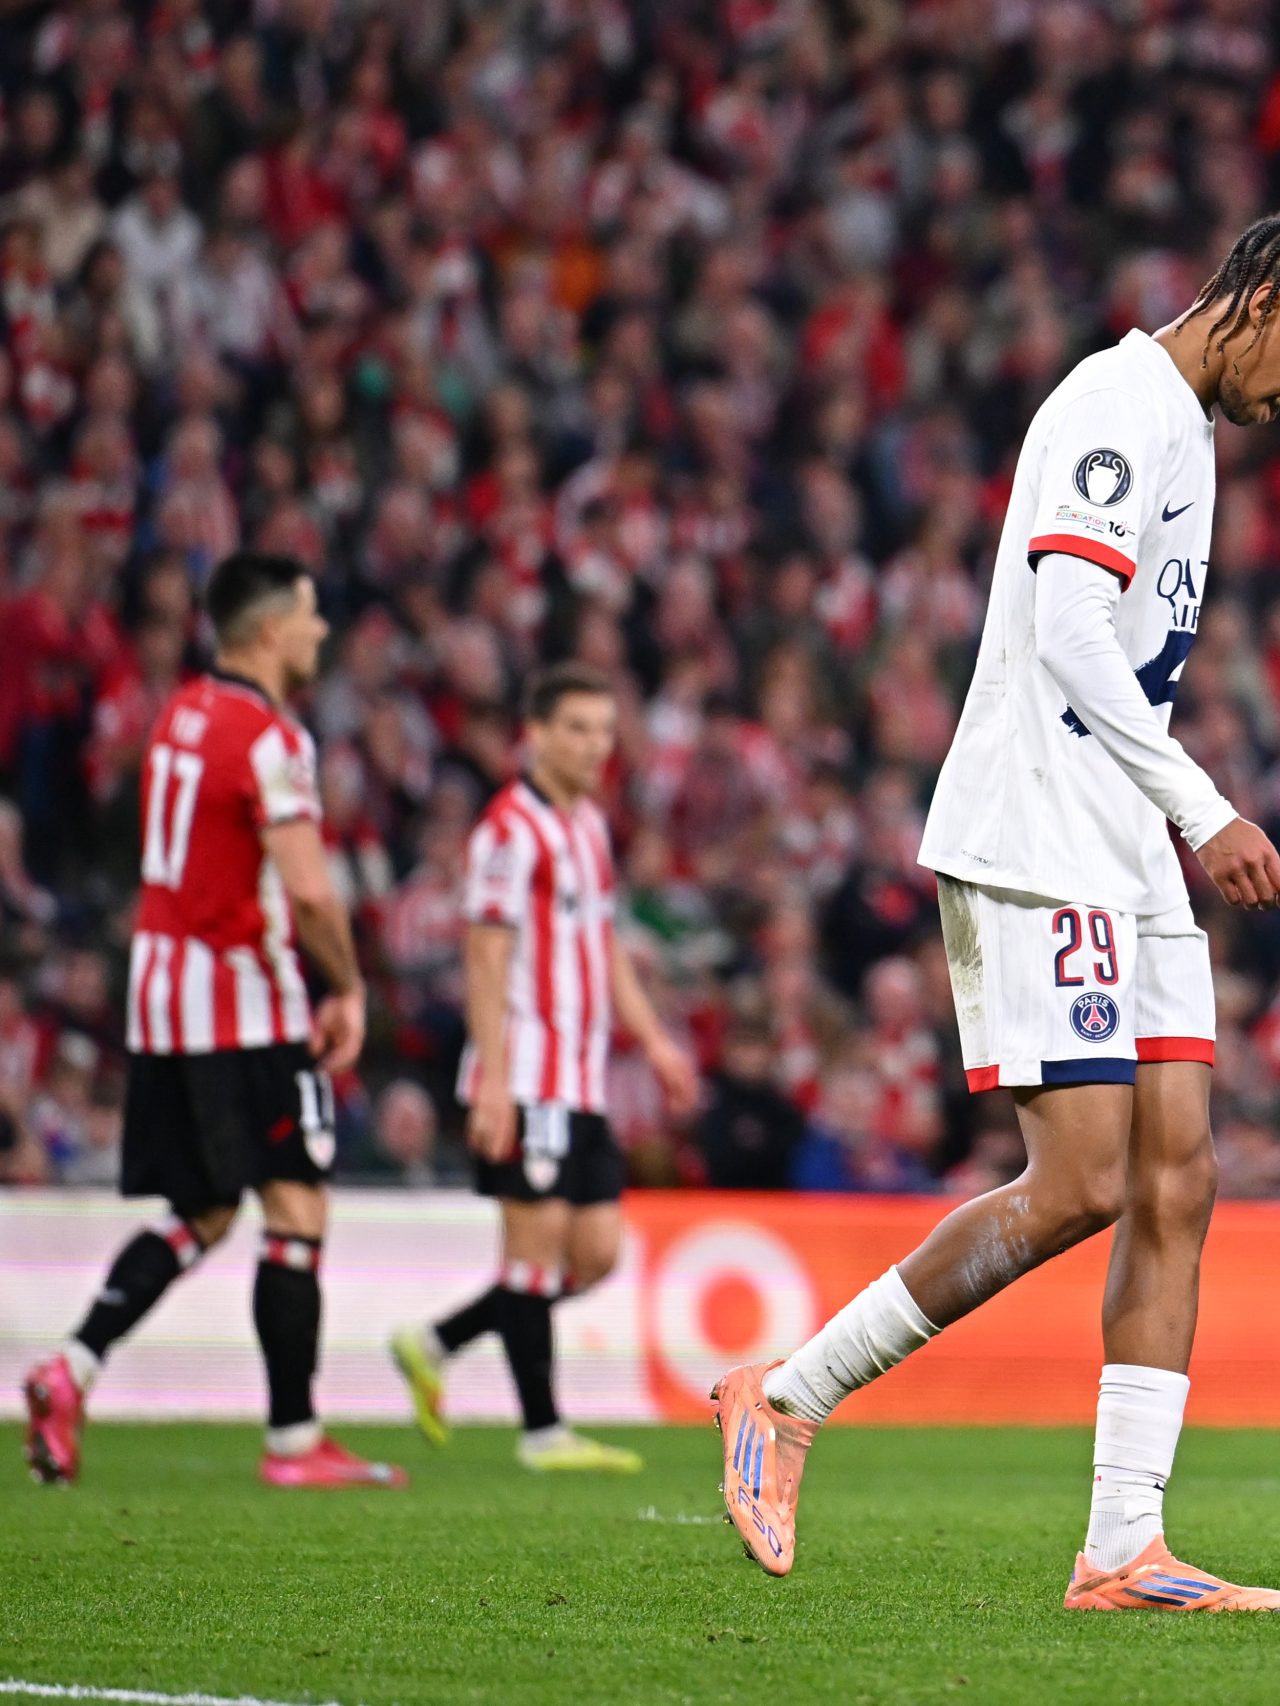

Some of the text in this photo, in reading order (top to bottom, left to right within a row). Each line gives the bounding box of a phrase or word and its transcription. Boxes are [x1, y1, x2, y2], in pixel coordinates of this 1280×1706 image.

[1056, 511, 1106, 527] FOUNDATION
[1109, 521, 1125, 537] 10
[142, 745, 204, 890] 17
[1052, 908, 1119, 987] 29
[1077, 996, 1109, 1009] PARIS
